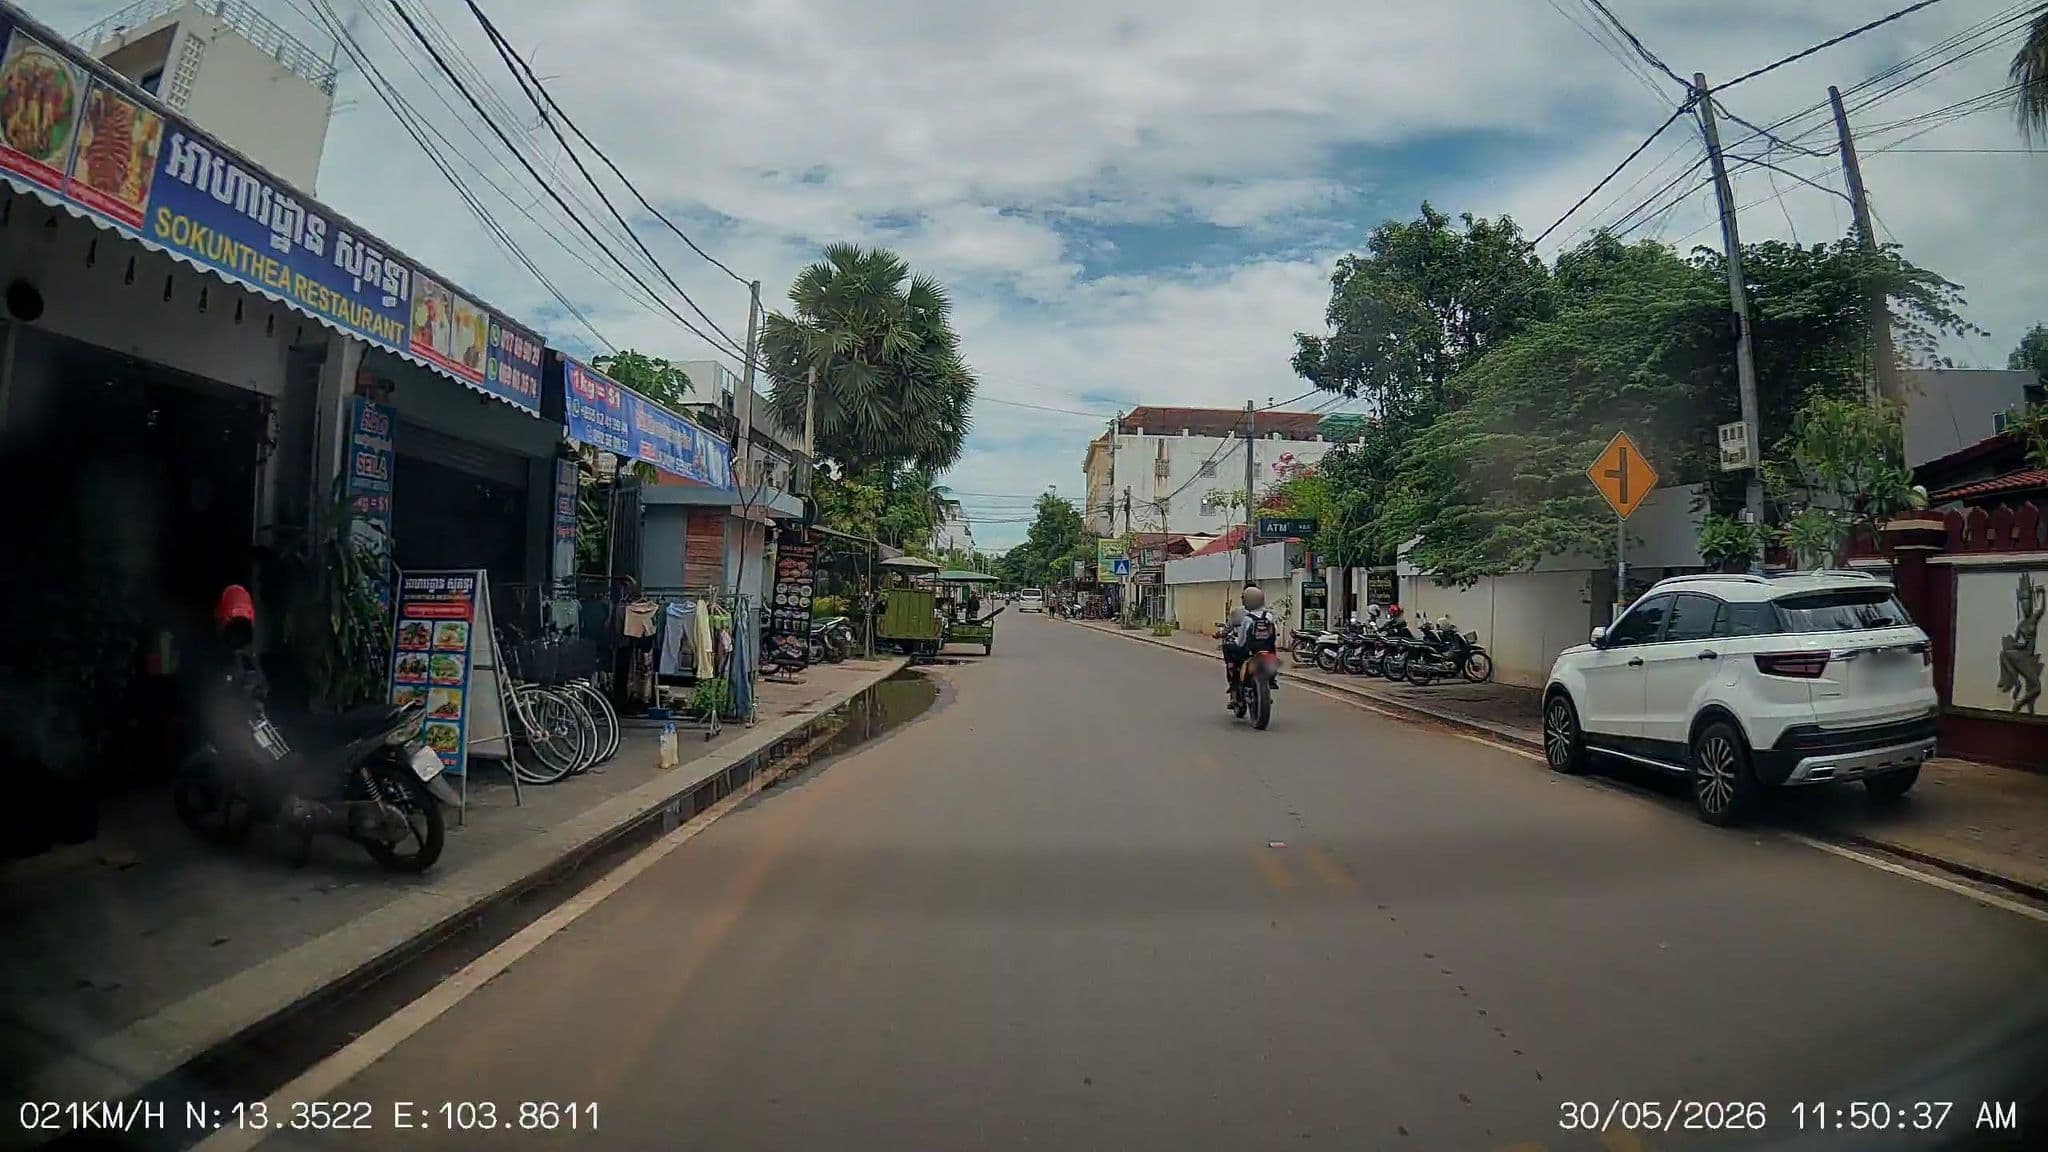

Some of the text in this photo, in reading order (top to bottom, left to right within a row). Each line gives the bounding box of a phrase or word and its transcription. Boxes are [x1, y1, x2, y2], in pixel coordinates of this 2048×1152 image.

[154, 206, 405, 345] SOKUNTHEA RESTAURANT
[1267, 523, 1287, 532] ATM
